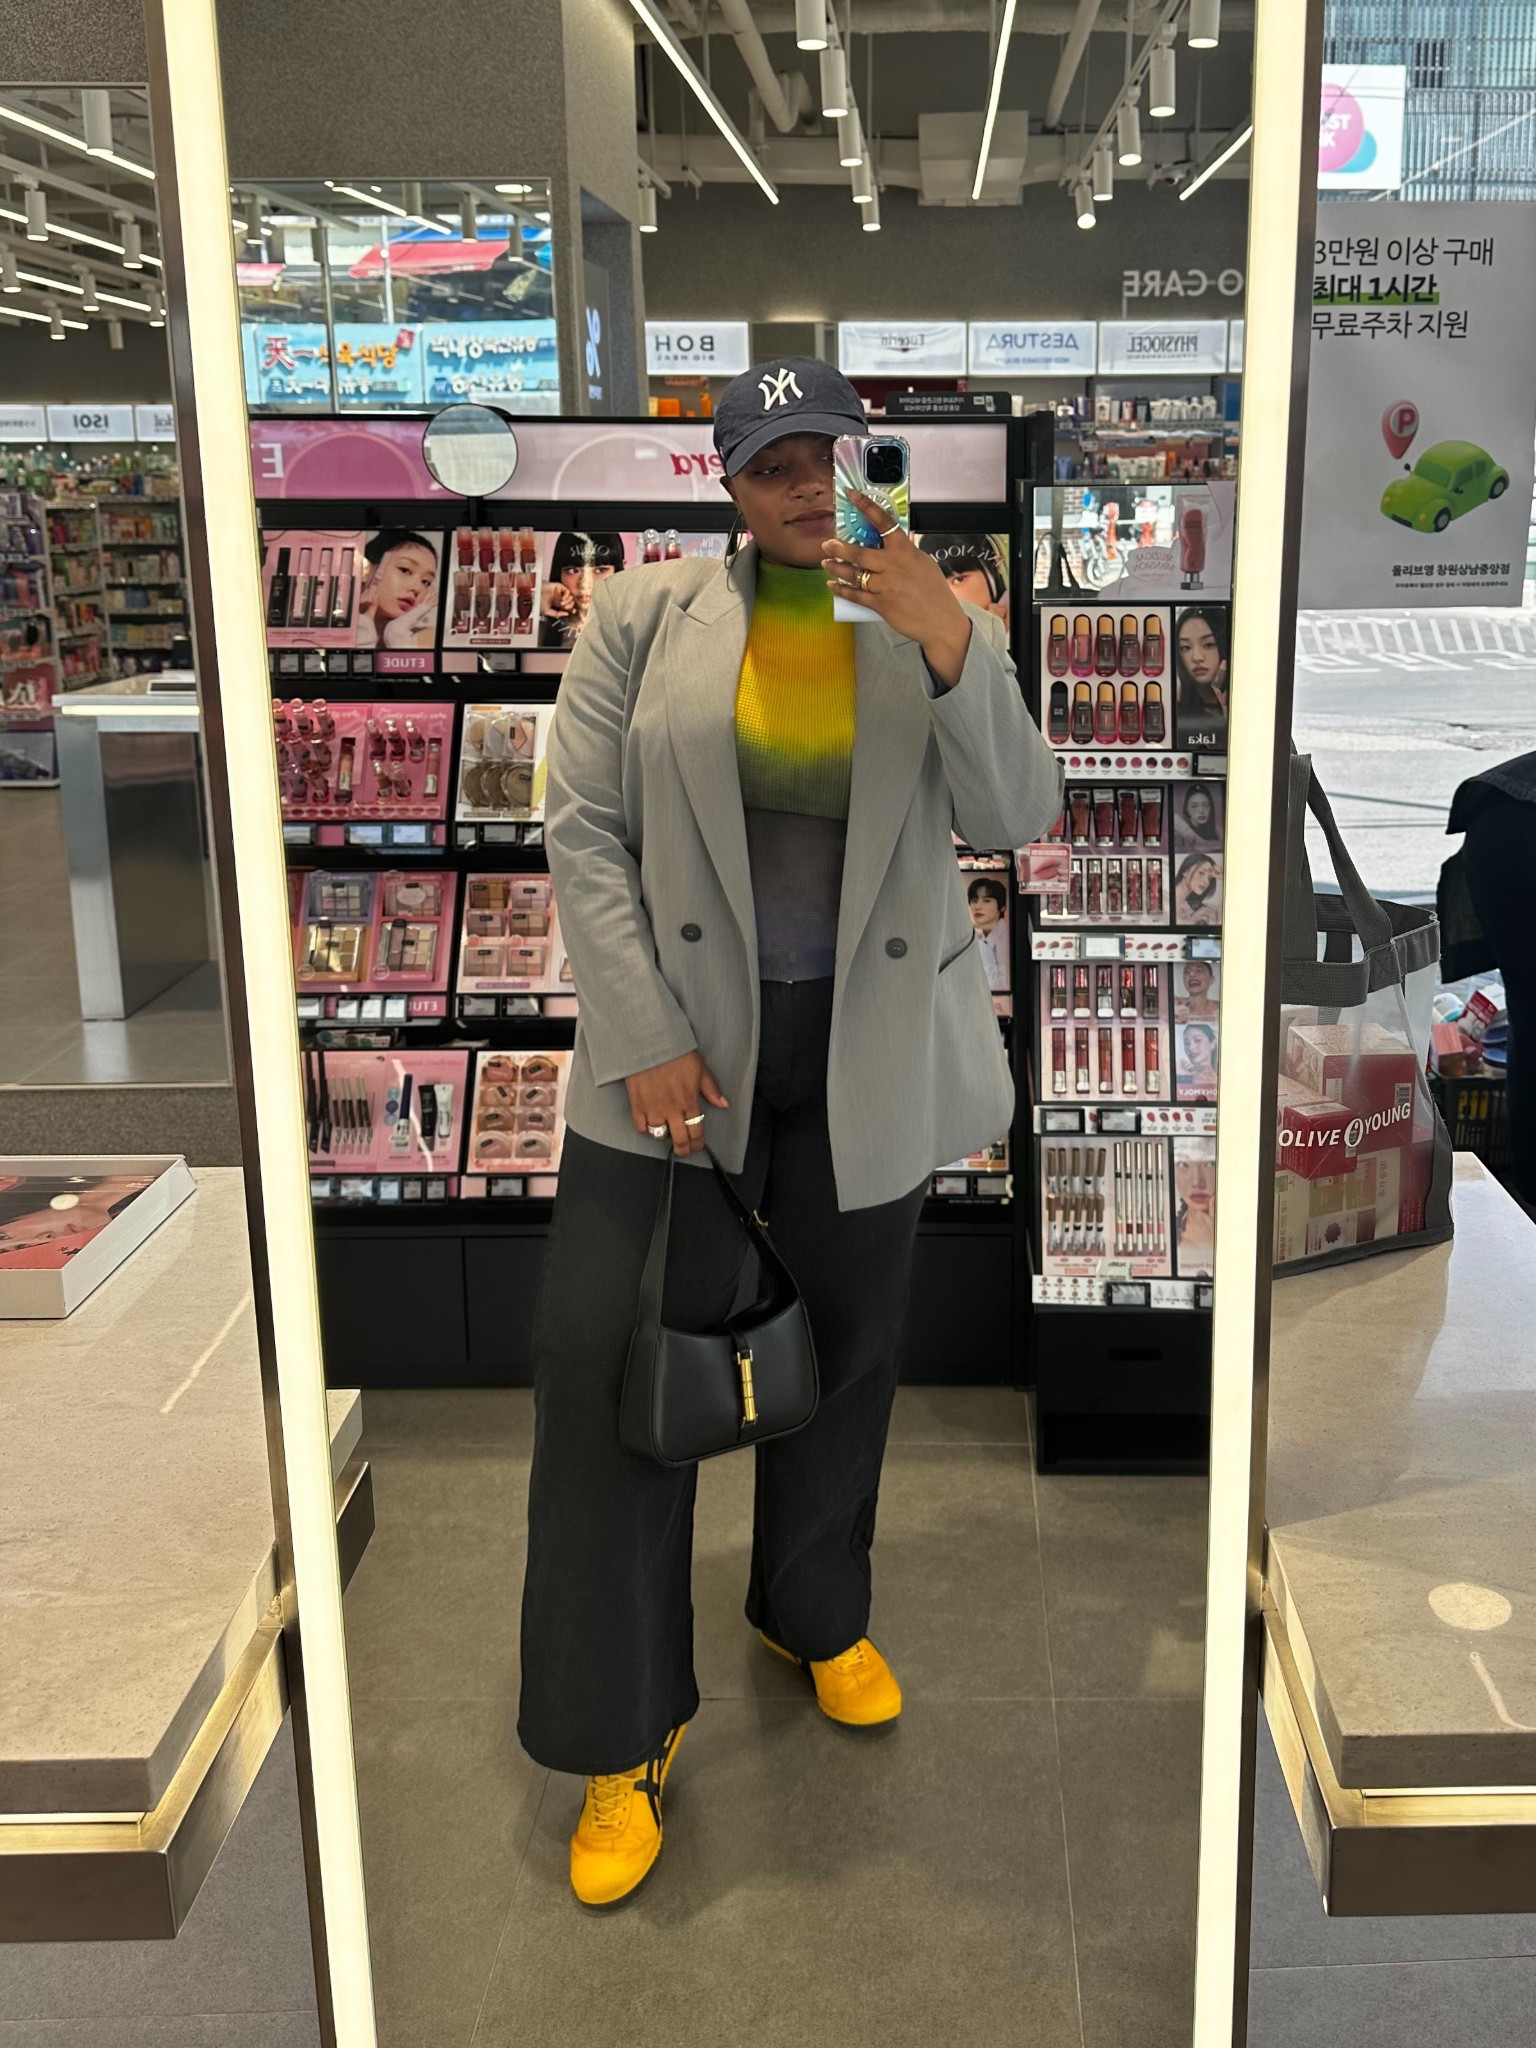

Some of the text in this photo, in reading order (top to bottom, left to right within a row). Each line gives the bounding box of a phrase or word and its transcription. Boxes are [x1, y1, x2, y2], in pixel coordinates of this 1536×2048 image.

[1387, 237, 1439, 266] 이상
[1443, 237, 1494, 266] 구매
[1312, 273, 1437, 303] 최대 1시간
[1311, 310, 1468, 340] 무료주차 지원
[1391, 565, 1434, 577] 올리브영
[1278, 1128, 1342, 1147] OLIVE
[1364, 1102, 1412, 1135] YOUNG
